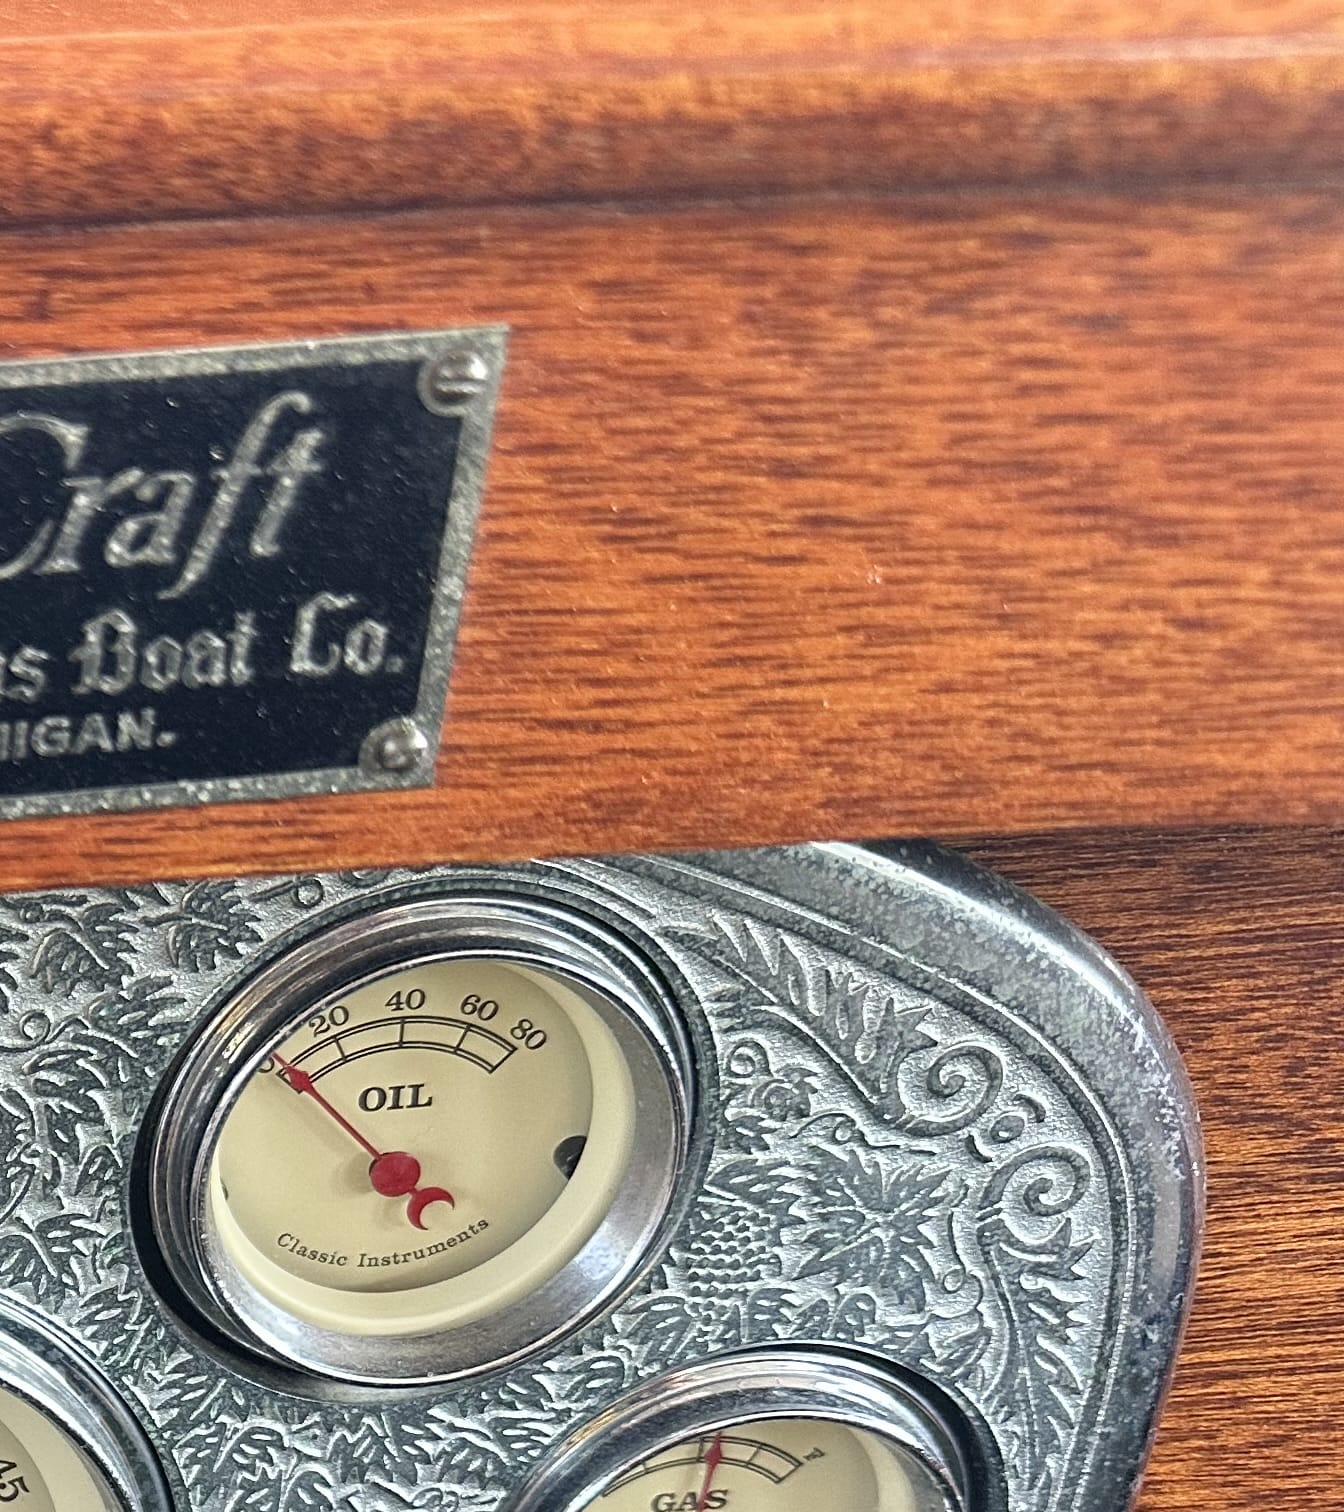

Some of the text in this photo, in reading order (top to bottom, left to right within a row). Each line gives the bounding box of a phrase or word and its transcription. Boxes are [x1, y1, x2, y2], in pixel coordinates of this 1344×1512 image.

[70, 608, 258, 696] Boat
[292, 592, 405, 676] Co.
[308, 988, 548, 1051] 20 40 60 80
[358, 1082, 433, 1112] OIL
[277, 1217, 490, 1267] Classic Instruments
[651, 1488, 729, 1512] GAS
